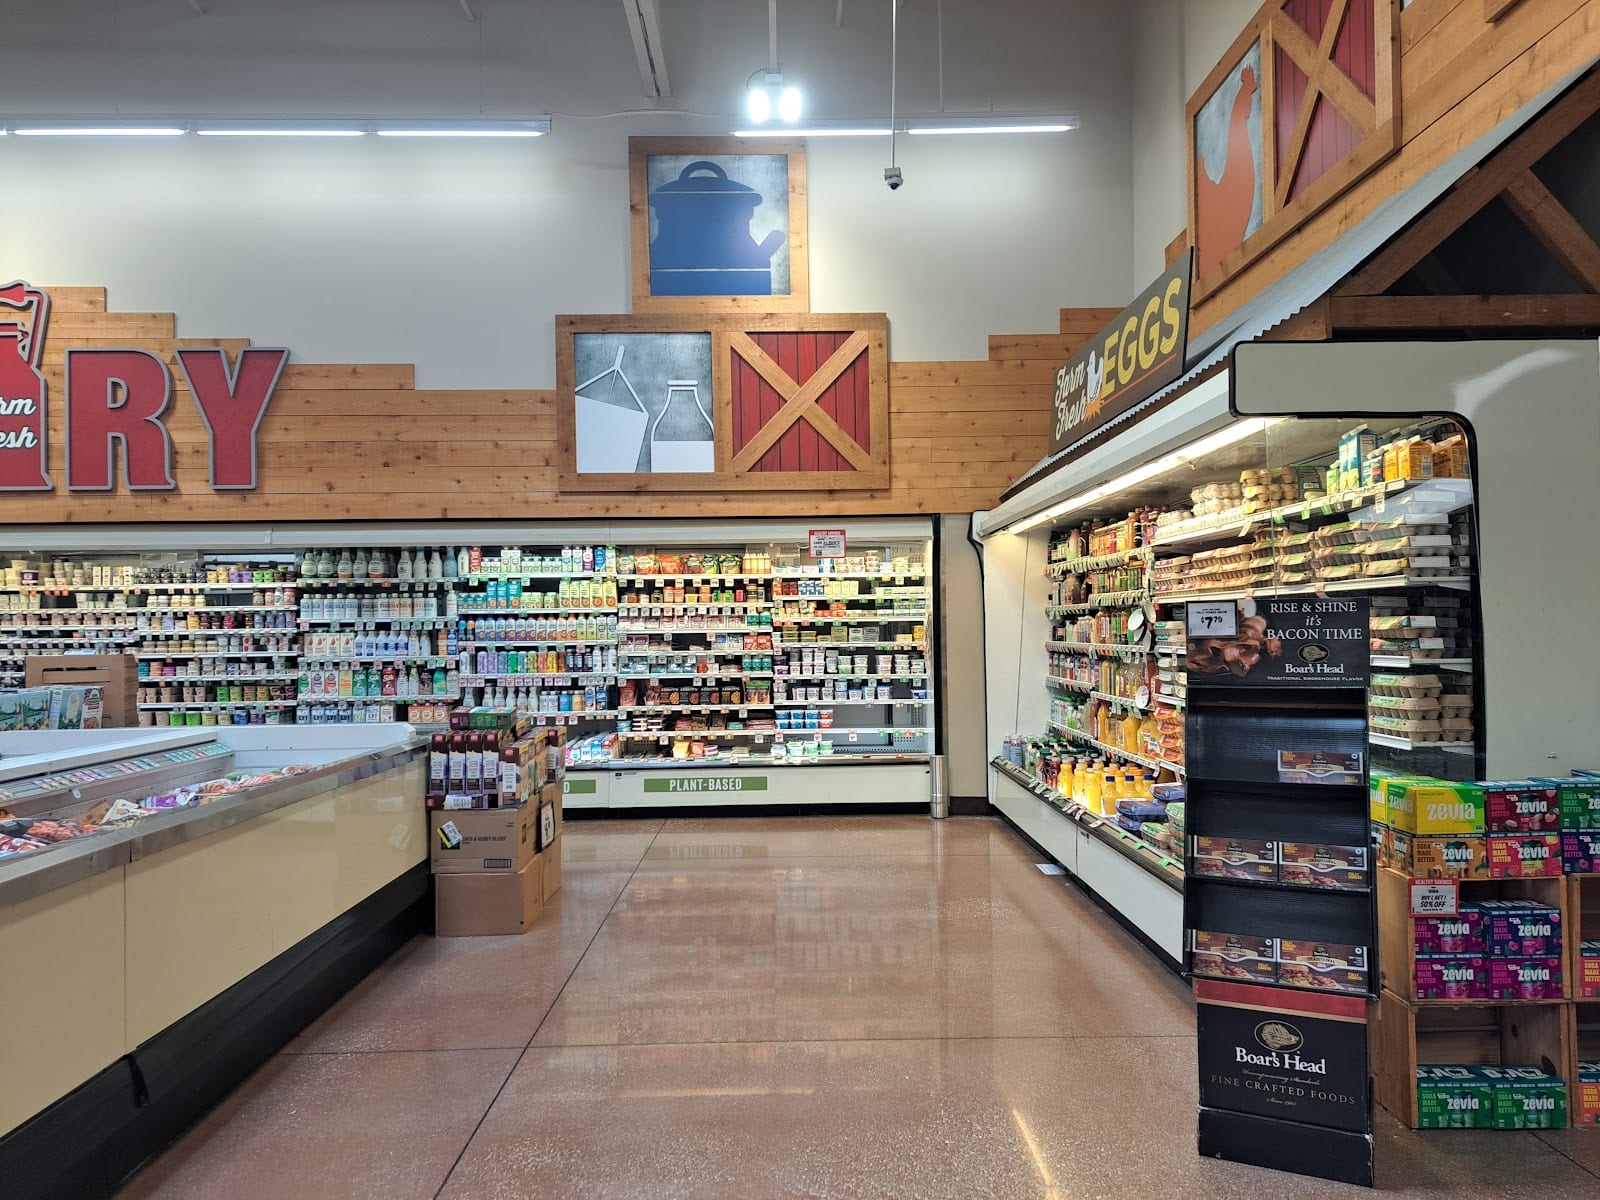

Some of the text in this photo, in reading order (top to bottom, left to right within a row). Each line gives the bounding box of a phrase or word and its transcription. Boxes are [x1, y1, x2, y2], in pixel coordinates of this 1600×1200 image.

[1101, 277, 1181, 399] EGGS
[1055, 361, 1085, 407] Farm
[1055, 390, 1087, 440] Fresh
[1270, 602, 1358, 614] RISE & SHINE
[1305, 615, 1322, 626] it's
[1266, 628, 1363, 640] BACON TIME
[1285, 664, 1344, 674] Boar's Head
[670, 778, 742, 792] PLANT-BASED
[1427, 802, 1475, 820] zevia
[1516, 799, 1548, 814] zevia
[1442, 847, 1474, 860] zevia
[1518, 845, 1550, 859] zevia
[1438, 922, 1470, 935] zevia
[1518, 924, 1550, 937] zevia
[1442, 966, 1474, 981] zevia
[1518, 967, 1550, 981] zevia
[1235, 1046, 1327, 1074] Boar's Head
[1211, 1074, 1356, 1104] FINE CRAFTED FOODS
[1447, 1095, 1480, 1110] zevia
[1522, 1096, 1554, 1110] zevia
